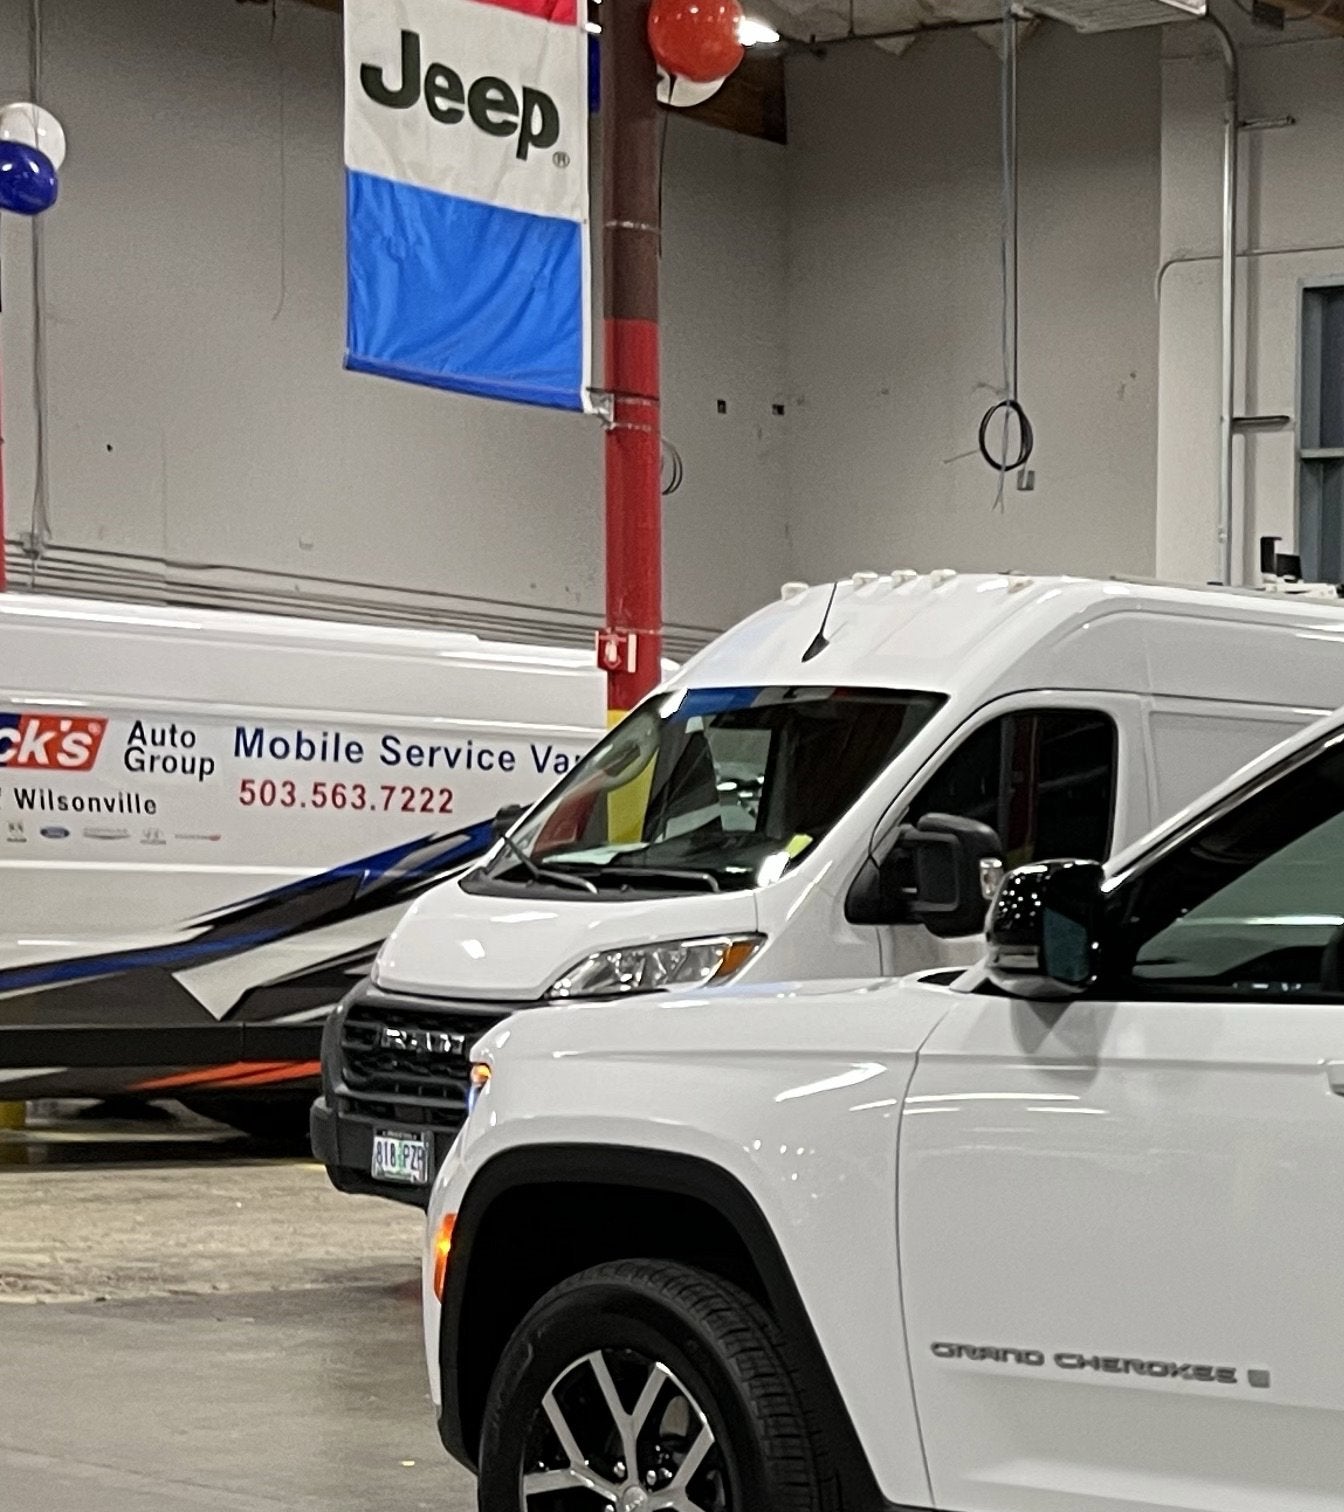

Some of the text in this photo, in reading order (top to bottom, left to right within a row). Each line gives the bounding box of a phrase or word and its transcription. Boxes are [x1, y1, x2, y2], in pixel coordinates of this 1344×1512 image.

[360, 29, 559, 161] Jeep
[127, 720, 196, 749] Auto
[234, 726, 580, 775] Mobile Service Va
[124, 746, 215, 782] Group
[14, 787, 157, 815] Wilsonville
[239, 778, 455, 815] 503.563.7222
[930, 1341, 1045, 1367] GRAND
[1053, 1352, 1238, 1384] CHEROKEE
